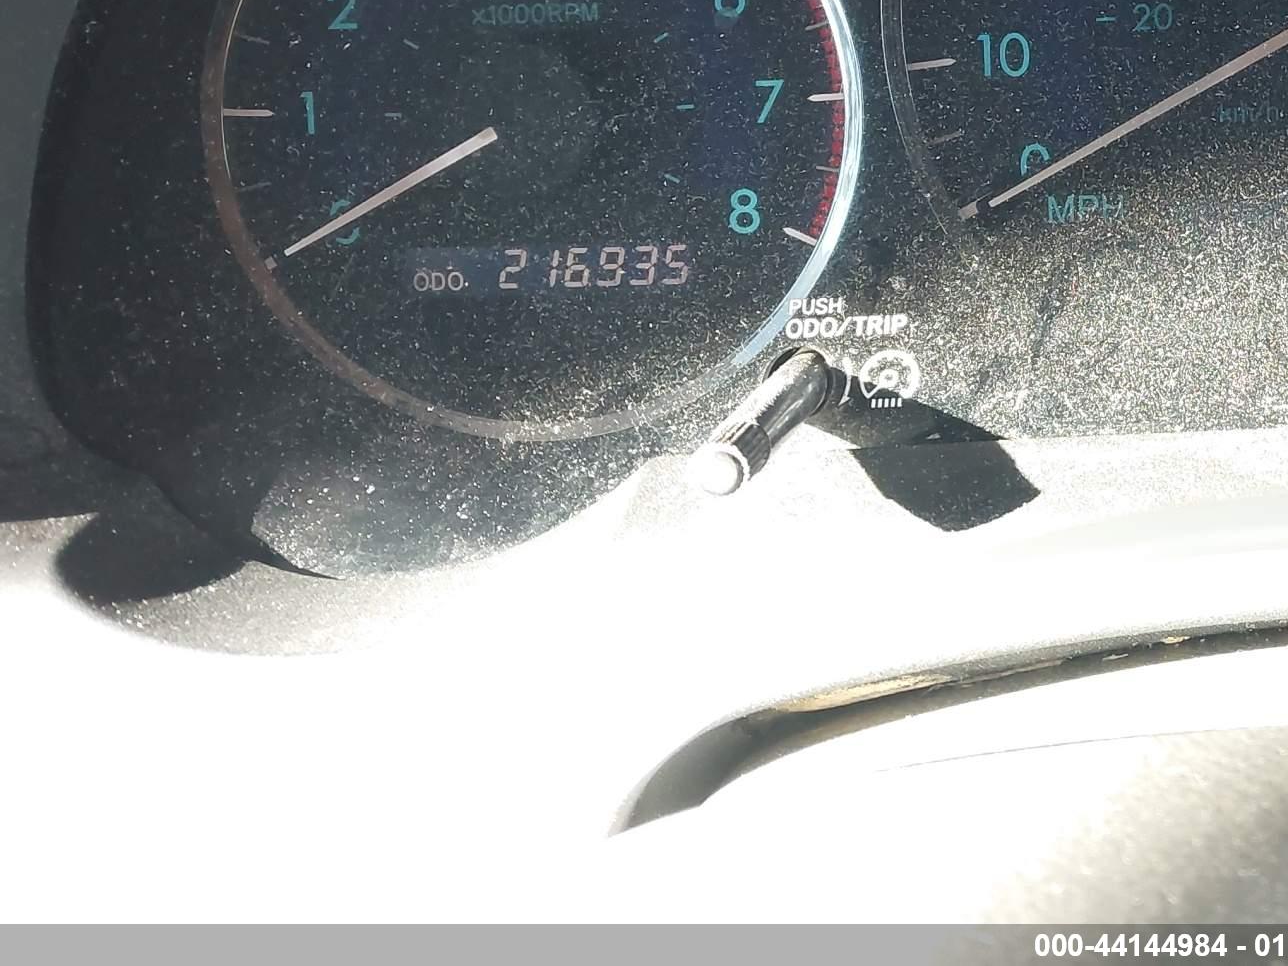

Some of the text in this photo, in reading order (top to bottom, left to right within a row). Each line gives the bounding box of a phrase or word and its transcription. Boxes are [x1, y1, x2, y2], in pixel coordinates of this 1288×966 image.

[1134, 4, 1173, 32] 20
[977, 33, 1030, 77] 10
[301, 91, 315, 134] 1
[755, 79, 784, 124] 7
[729, 189, 760, 234] 8
[1047, 194, 1124, 223] MPH
[499, 244, 688, 289] 216935
[785, 312, 907, 338] ODO/TRIP
[789, 298, 844, 317] PUSH
